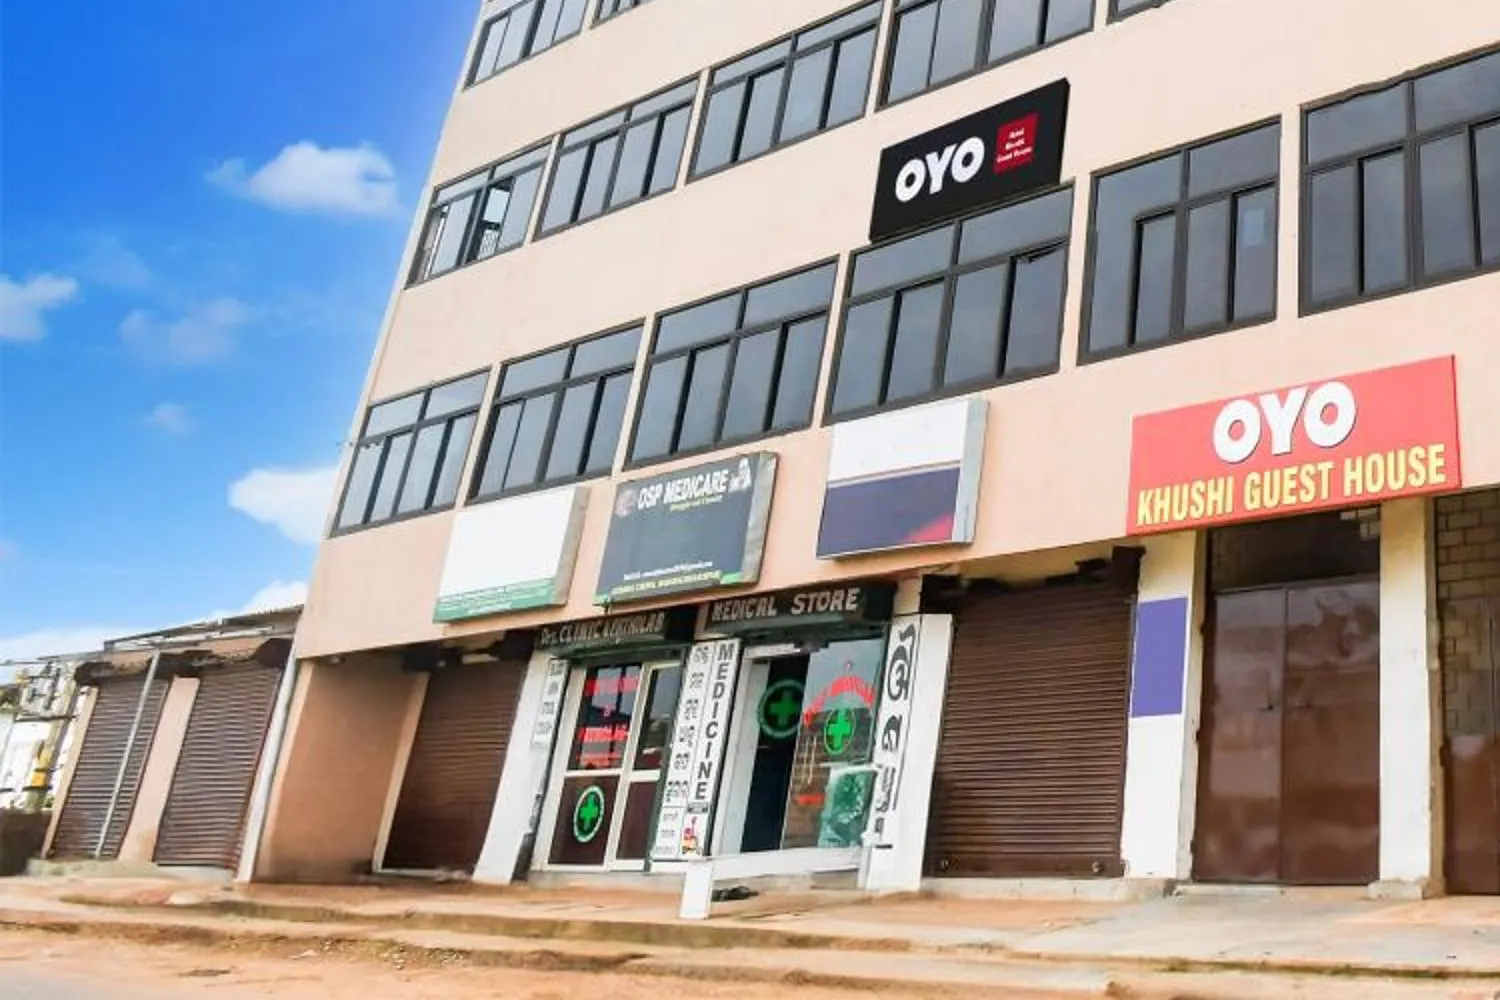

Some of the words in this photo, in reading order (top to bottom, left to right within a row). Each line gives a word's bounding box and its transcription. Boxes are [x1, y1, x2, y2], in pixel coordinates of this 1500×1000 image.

[895, 136, 985, 202] OYO
[1213, 381, 1357, 464] OYO
[663, 468, 729, 504] MEDICARE
[1136, 476, 1234, 526] KHUSHI
[1244, 461, 1335, 511] GUEST
[1343, 443, 1446, 497] HOUSE
[711, 597, 778, 622] MEDICAL
[790, 587, 861, 615] STORE
[695, 643, 735, 801] MEDICINE
